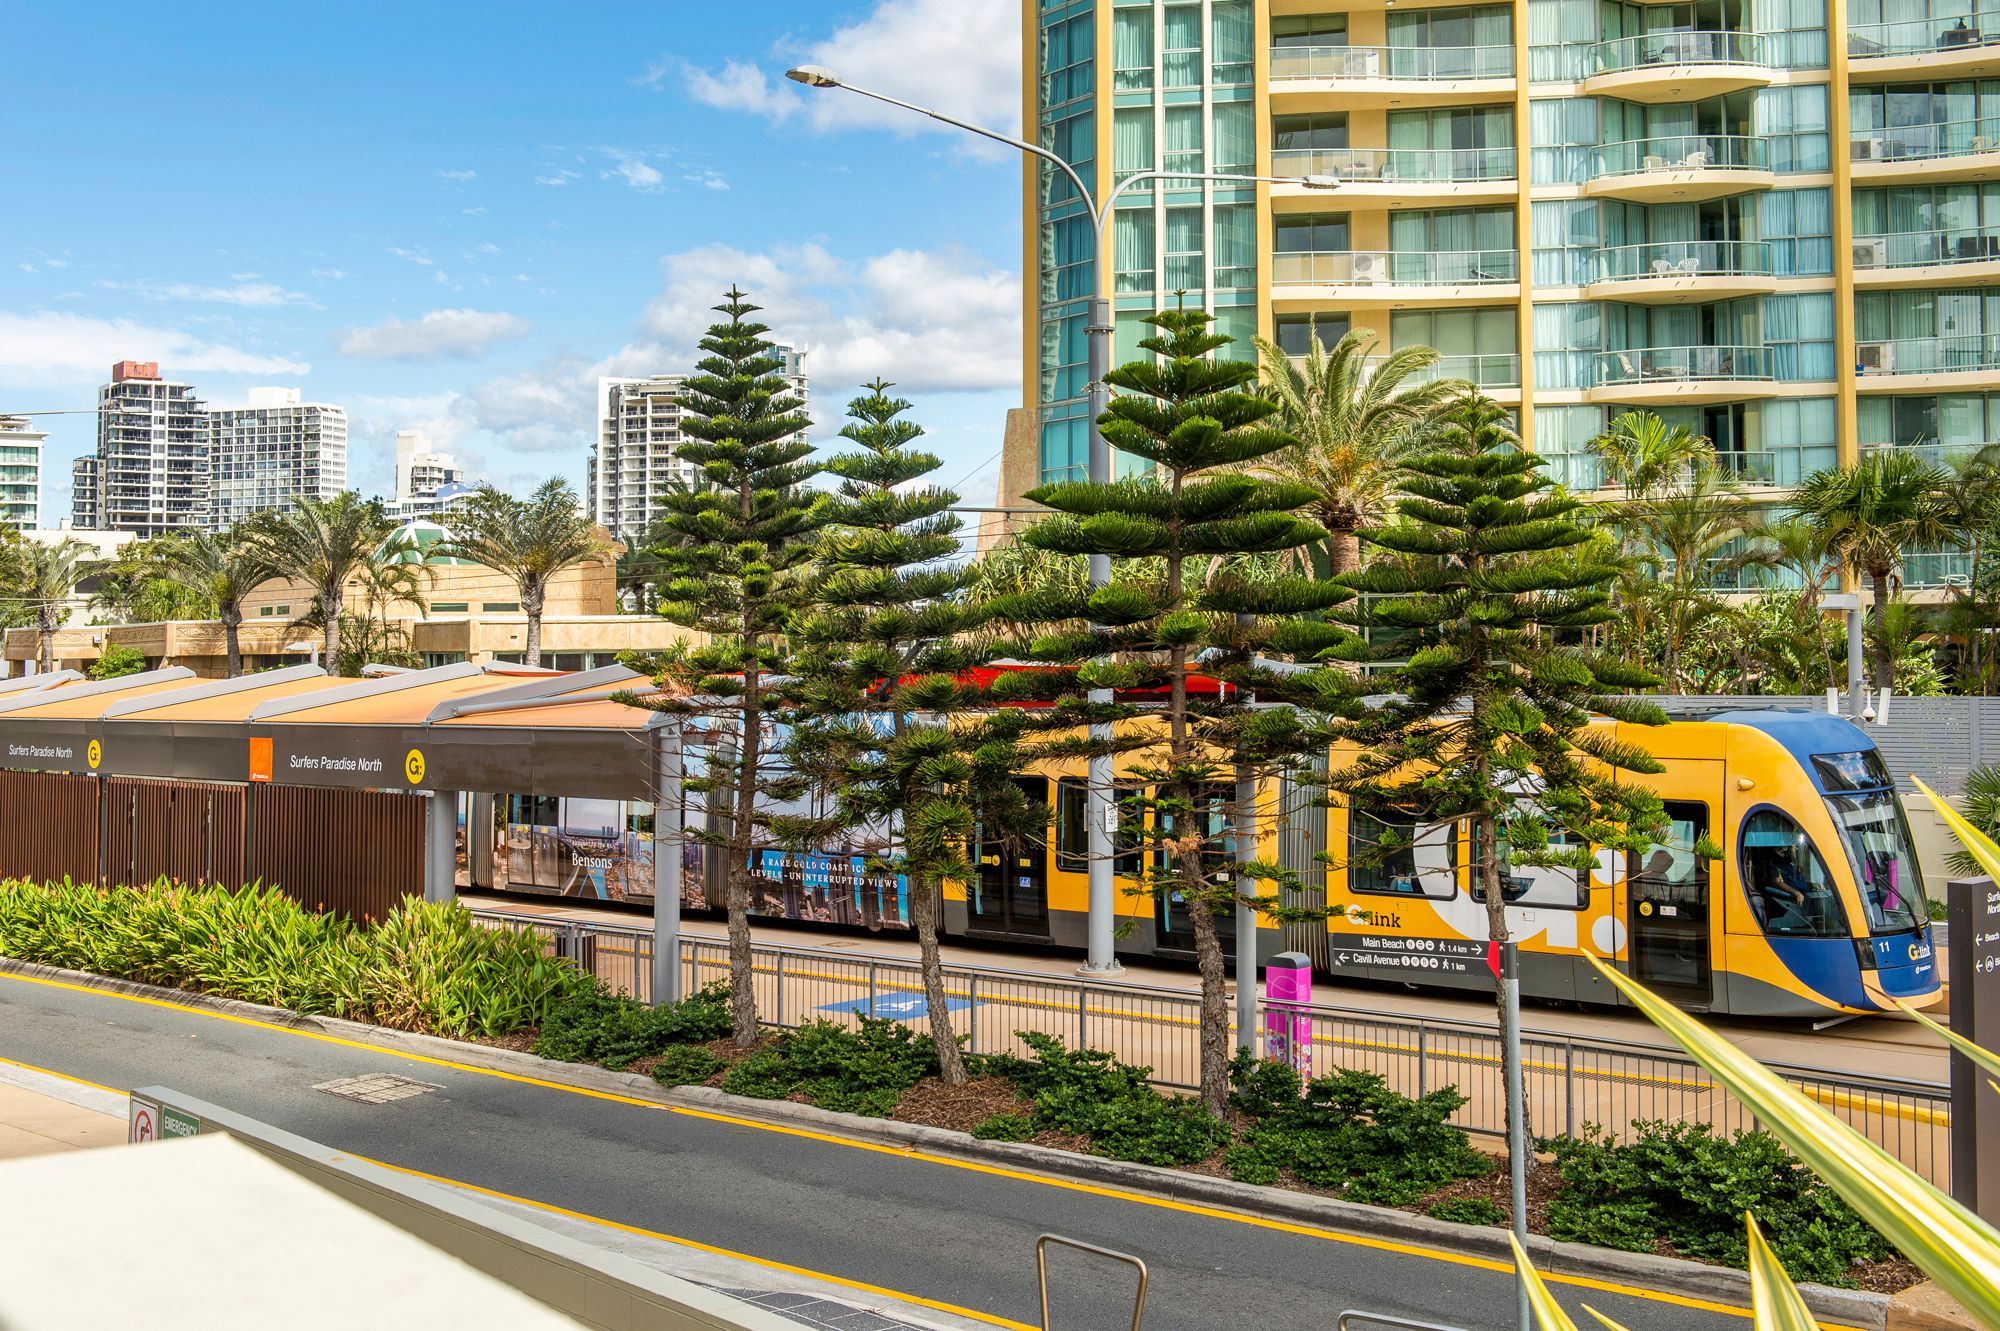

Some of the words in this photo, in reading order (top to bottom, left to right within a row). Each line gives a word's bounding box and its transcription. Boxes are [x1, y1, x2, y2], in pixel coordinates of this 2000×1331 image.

[9, 744, 29, 756] Surfers
[30, 745, 54, 757] Paradise
[56, 747, 72, 758] North
[290, 755, 318, 769] Surfers
[320, 756, 355, 771] Paradise
[358, 758, 382, 772] North
[572, 850, 613, 869] Bensons
[820, 863, 849, 872] COAST
[868, 879, 898, 888] VIEWS
[1985, 932, 2000, 942] Beach
[1362, 938, 1380, 948] Main
[1382, 939, 1405, 950] Beach
[1448, 945, 1457, 953] 1.4
[1458, 945, 1467, 953] km
[1879, 941, 1890, 953] 11
[1353, 953, 1373, 964] Cavill
[1374, 955, 1400, 966] Avenue
[1456, 963, 1466, 971] km
[165, 1116, 197, 1137] EMERGENCY
